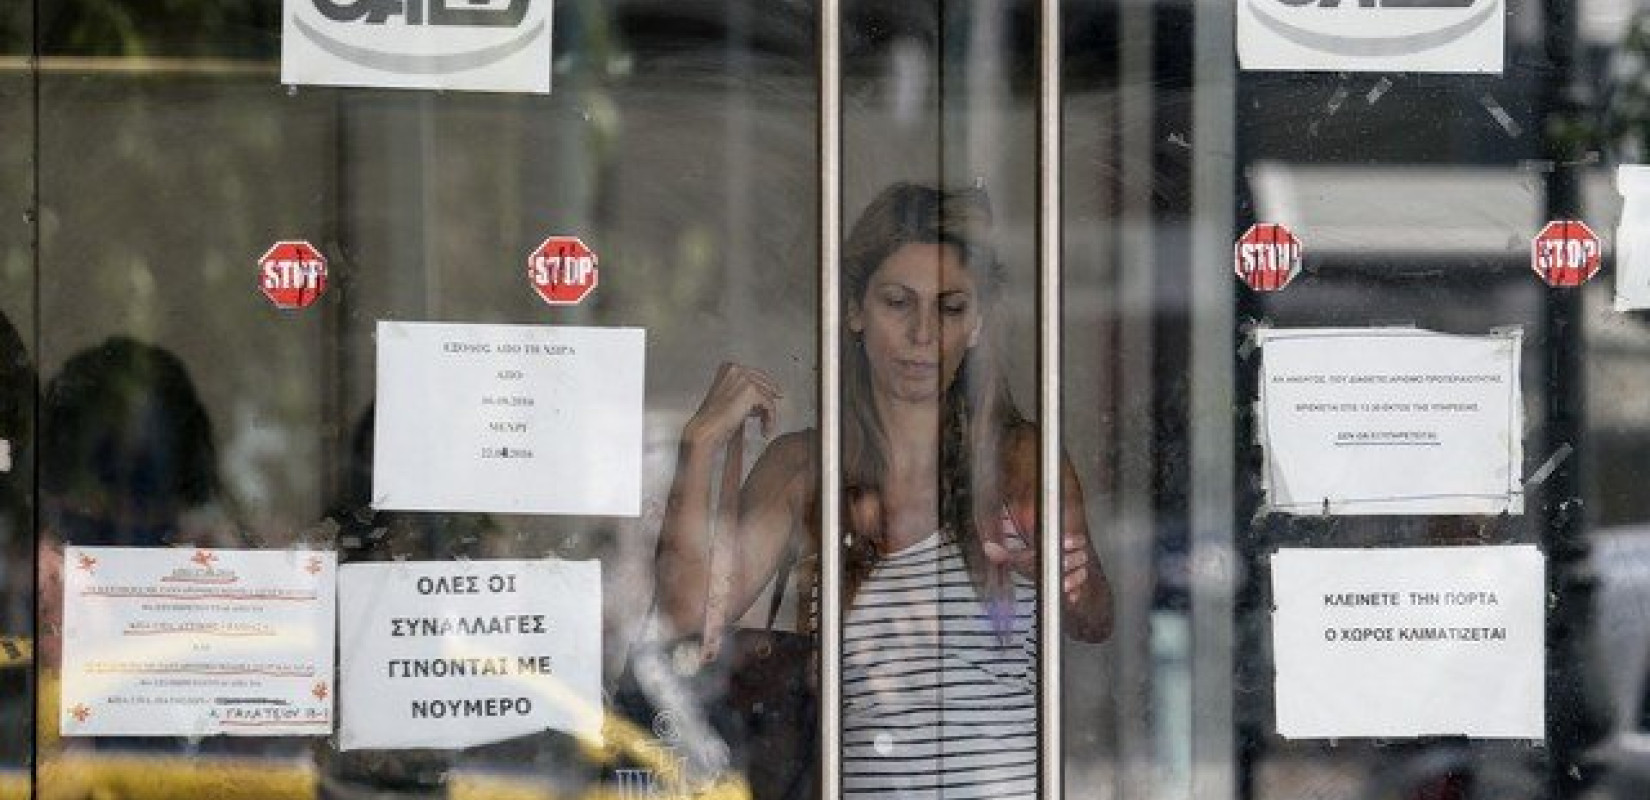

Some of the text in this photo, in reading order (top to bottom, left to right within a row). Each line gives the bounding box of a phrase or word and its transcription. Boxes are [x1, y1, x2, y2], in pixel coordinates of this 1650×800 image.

[535, 256, 592, 286] STOP
[416, 573, 517, 595] ΟΛΕΣ ΟΙ
[1324, 591, 1499, 606] ΚΛΕΙΝΕΤΕ ΤΗΝ ΠΟΡΤΑ
[390, 614, 548, 637] ΣΥΝΑΛΛΑΓΕΣ
[1324, 627, 1507, 642] Ο ΧΩΡΟΣ ΚΛΙΜΑΤΙΖΕΤΑΙ
[388, 656, 553, 678] ΓΙΝΟΝΤΑΙ ΜΕ
[411, 696, 533, 719] ΝΟΥΜΕΡΟ
